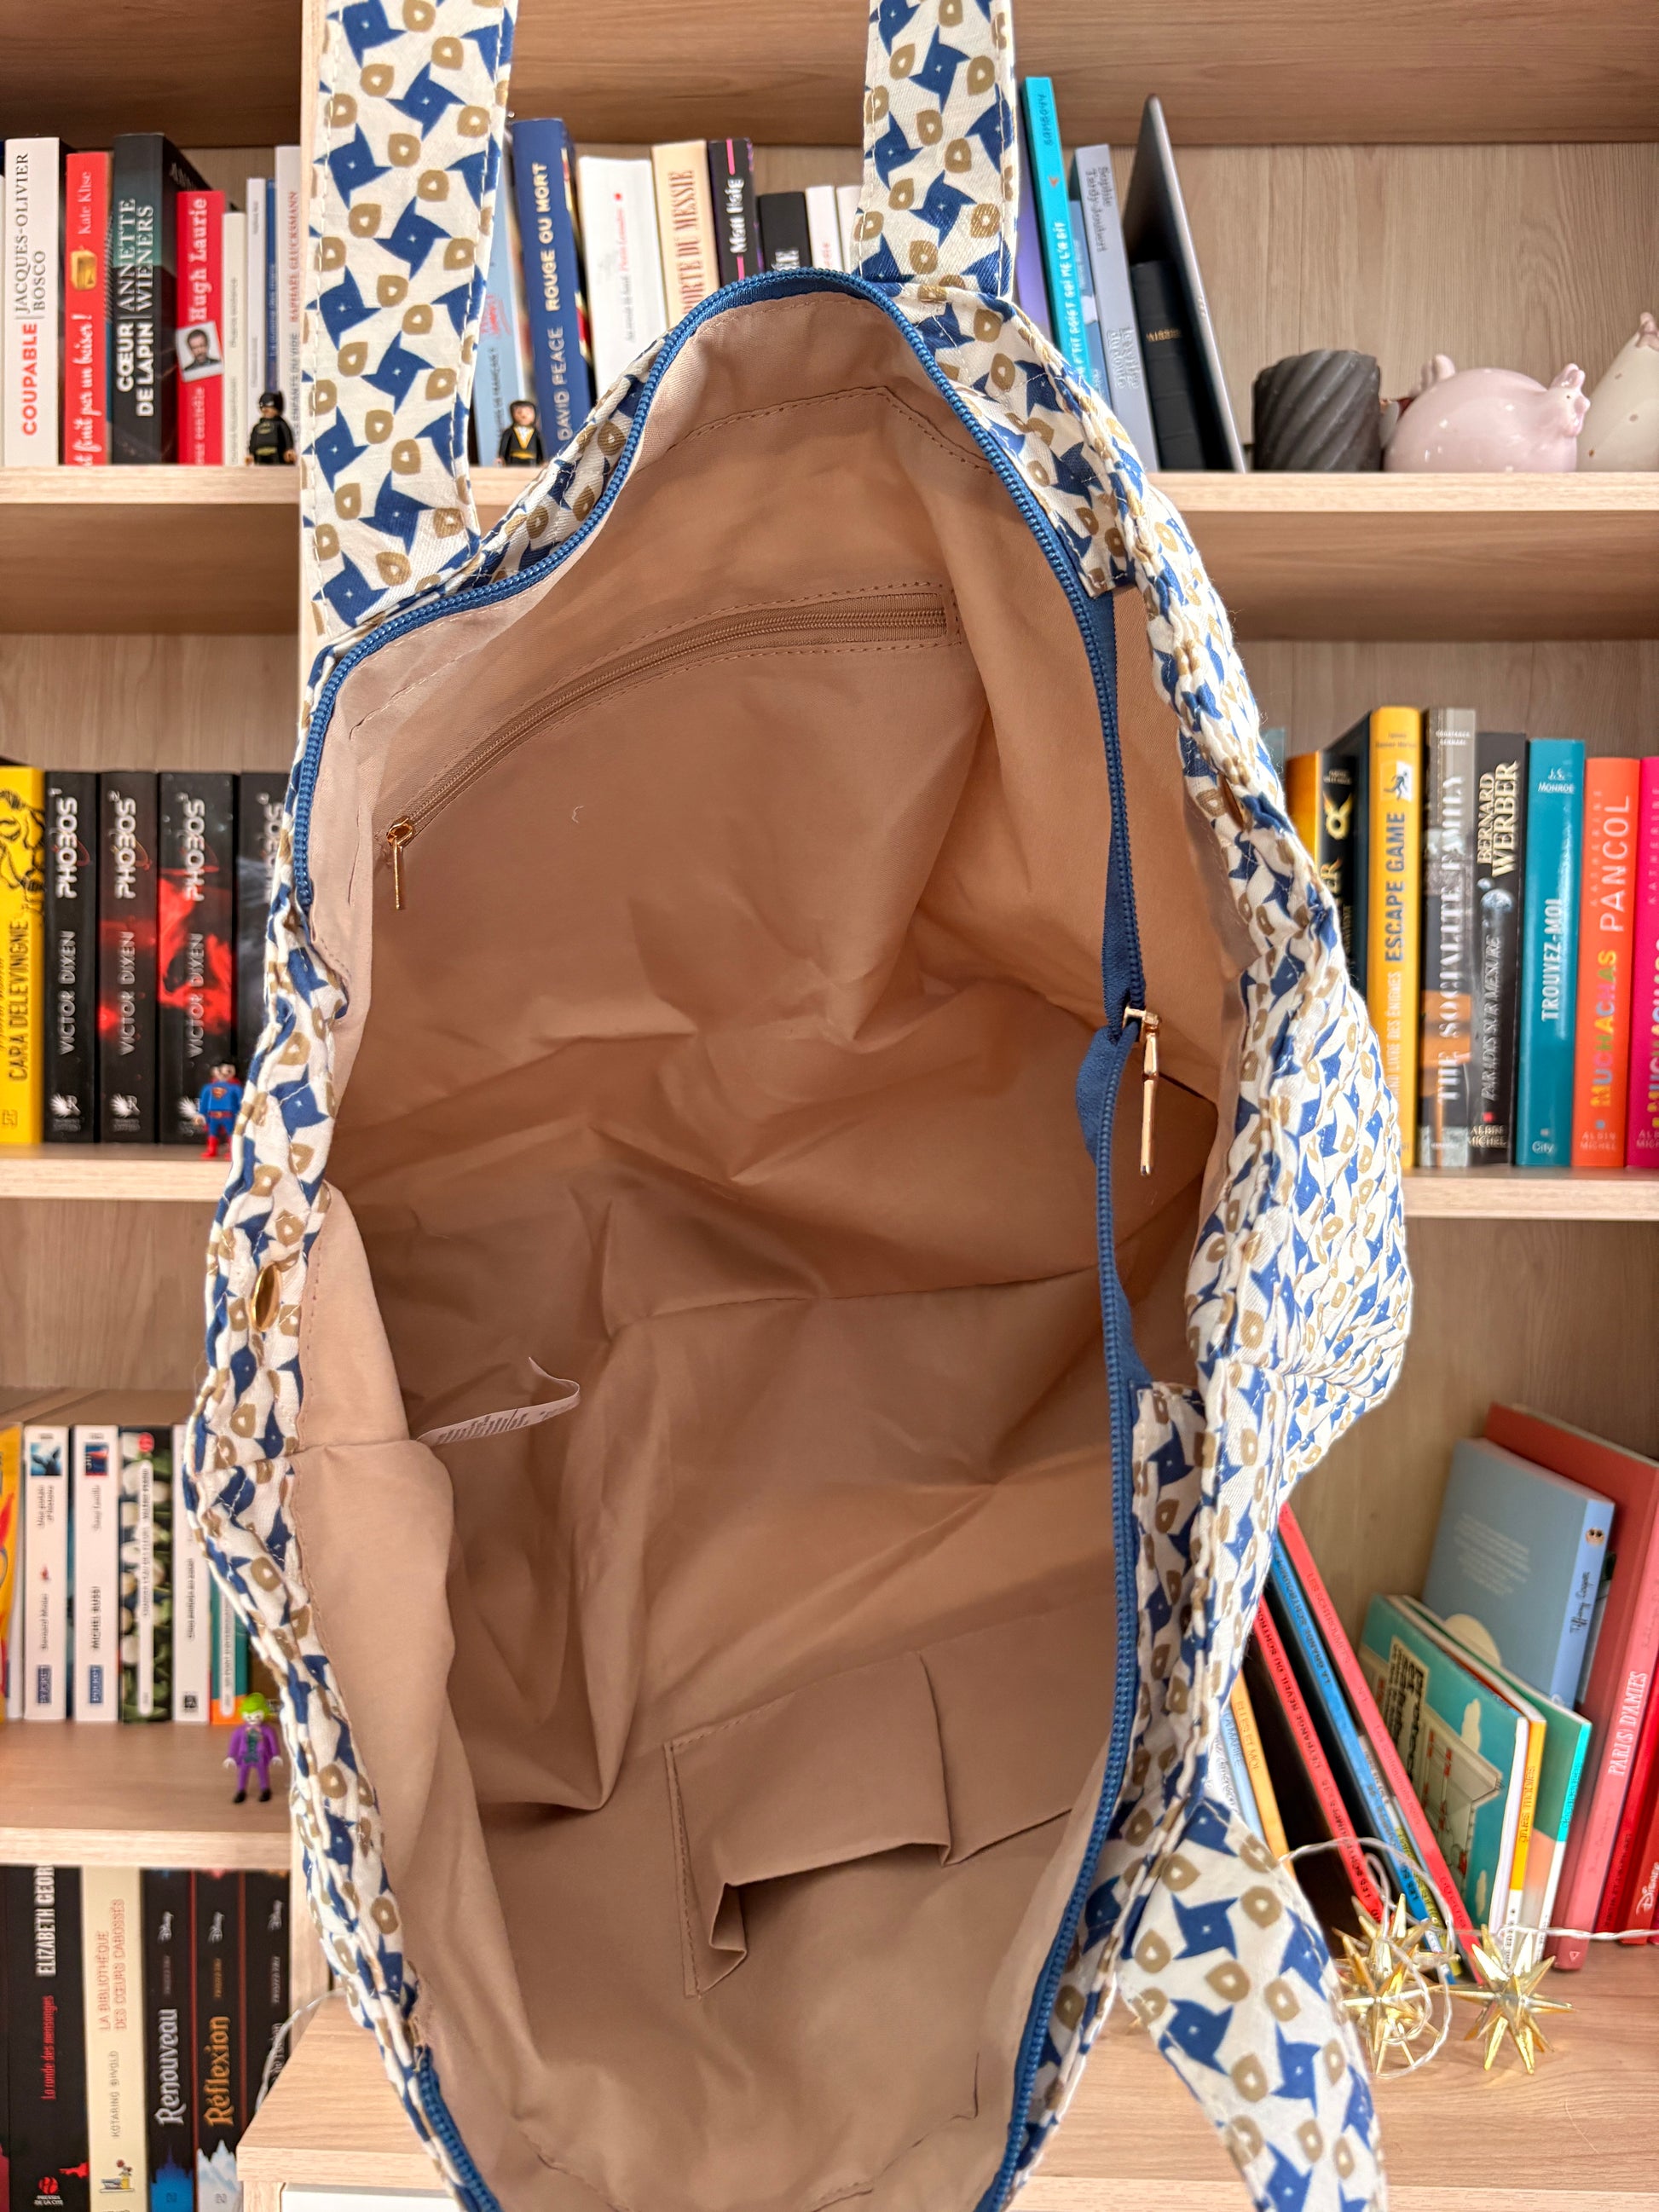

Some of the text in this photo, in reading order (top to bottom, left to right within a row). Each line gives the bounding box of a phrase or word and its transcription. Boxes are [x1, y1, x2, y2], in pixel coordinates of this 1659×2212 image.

[14, 152, 31, 313] JACQUES-OLIVIER
[78, 205, 91, 235] Kate
[118, 198, 136, 312] ANNETTE
[136, 205, 154, 311] WIENERS
[188, 198, 212, 321] Hugh Laurie
[532, 162, 560, 312] ROUGE OU MORT
[668, 170, 704, 312] PORTE DU MESSIE
[725, 178, 747, 252] Matt Haig
[32, 251, 46, 312] BOSCO
[22, 323, 38, 436] COUPABLE
[72, 321, 93, 365] baiser
[81, 367, 93, 389] un
[117, 322, 134, 392] CŒUR
[136, 322, 154, 416] DE LAPIN
[548, 326, 573, 441] DAVID PEACE
[72, 417, 102, 453] finit
[80, 391, 101, 416] par
[1477, 772, 1495, 863] BERNARD
[1492, 759, 1518, 877] WERBER
[1599, 795, 1629, 932] PANCOL
[1384, 811, 1405, 962] ESCAPE GAME
[1438, 775, 1463, 1102] THE SOCIALITE FAMILY
[9, 921, 28, 1081] CARA DELEVINGNE
[58, 931, 76, 1055] VICTOR DIXEN
[118, 931, 136, 1056] VICTOR DIXEN
[185, 933, 204, 1059] VICTOR DIXEN
[1541, 898, 1562, 1022] TROUVEZ-MOI
[1386, 1019, 1400, 1039] DES
[1482, 934, 1501, 1100] PARADIS SUR MESURE
[1590, 950, 1616, 1106] MUCHACHAS
[1532, 1141, 1555, 1153] City
[34, 1865, 56, 1977] ELIZABETH GEOR
[95, 1930, 110, 2031] LA BIBLIOTHÈQUE
[113, 2008, 127, 2030] DES
[40, 1995, 58, 2099] La ronde des mensonges
[153, 2008, 187, 2127] Renouveau
[203, 2016, 234, 2128] Réflexion
